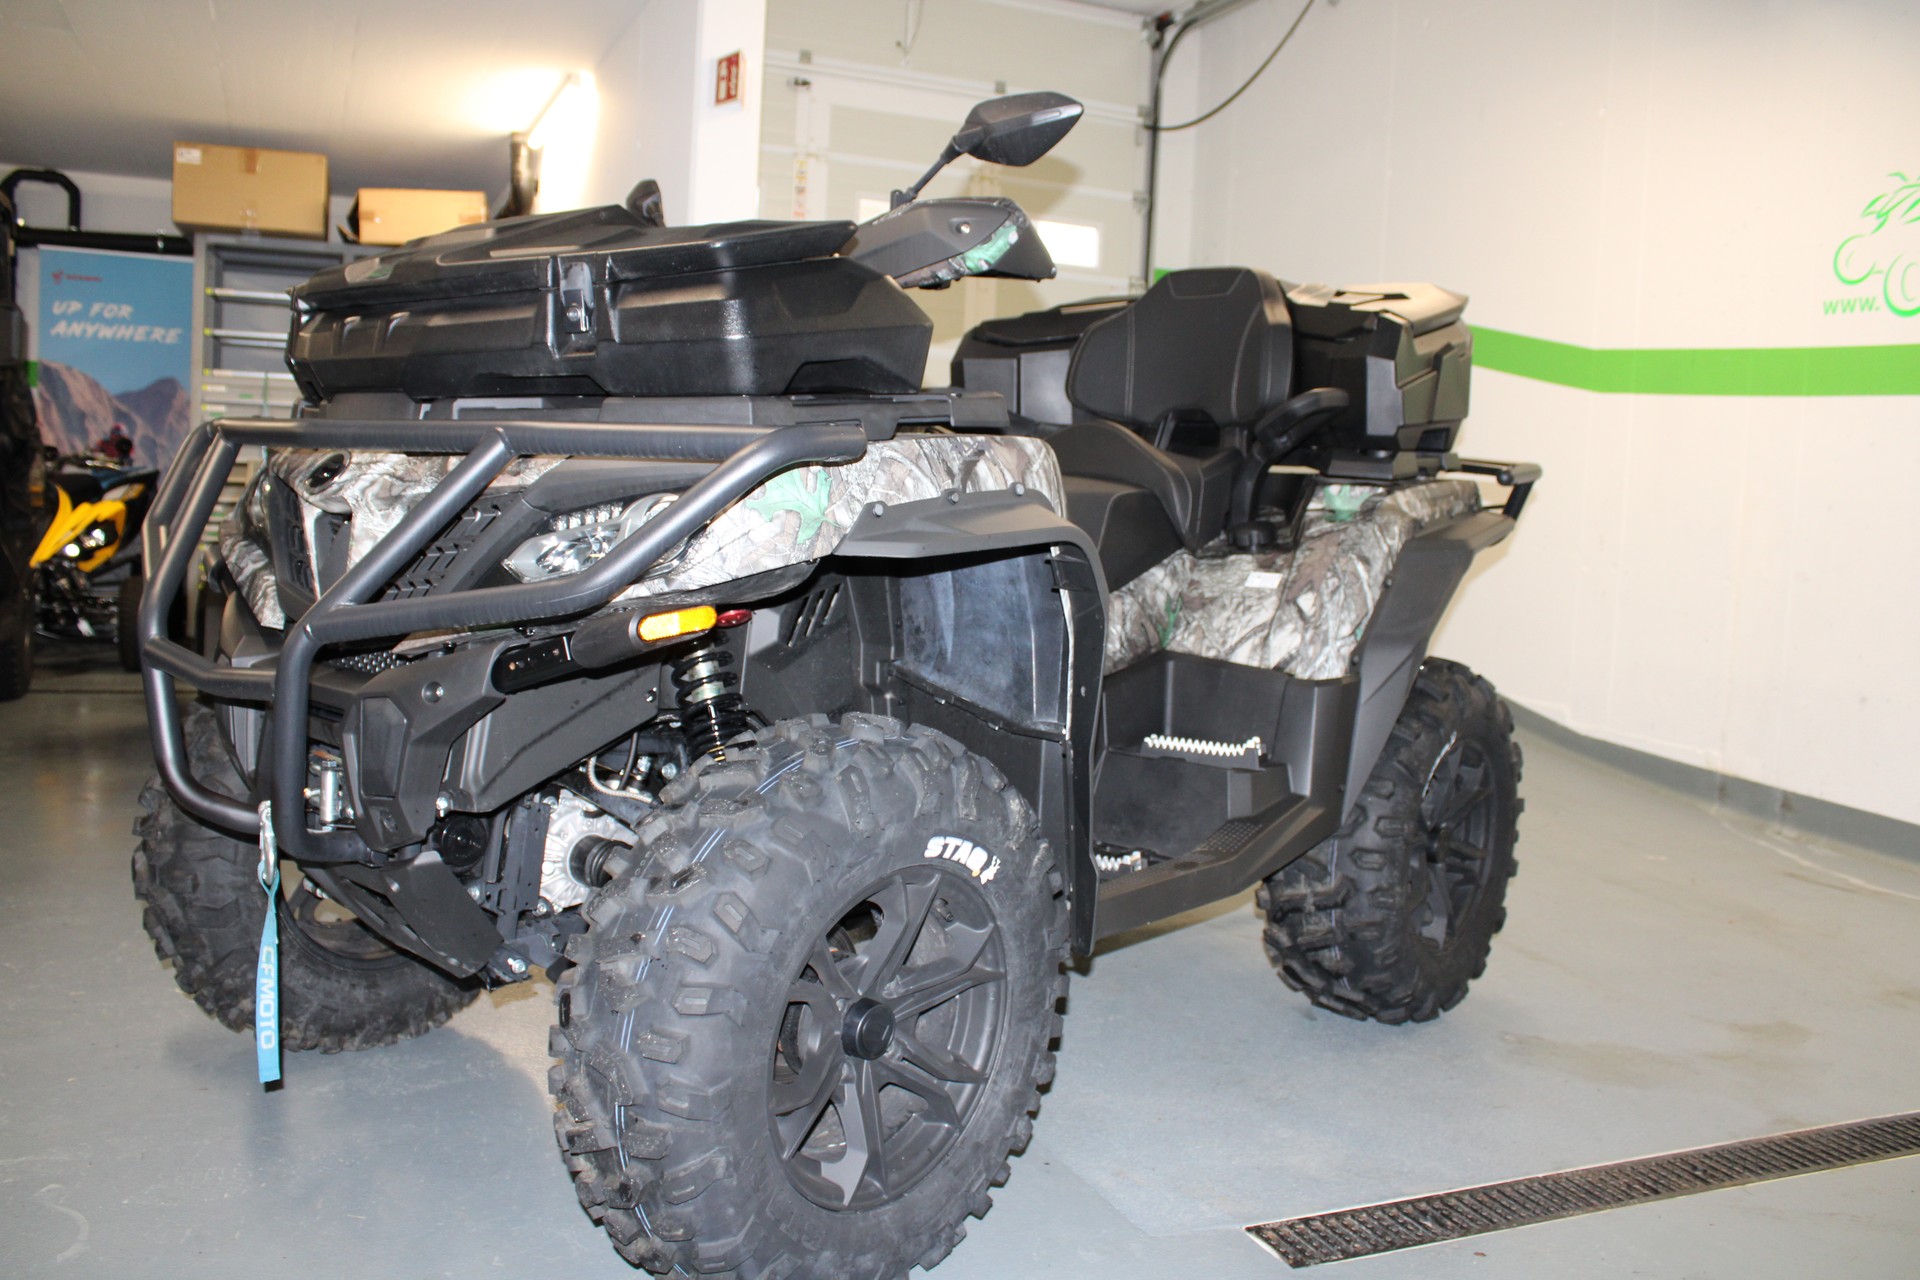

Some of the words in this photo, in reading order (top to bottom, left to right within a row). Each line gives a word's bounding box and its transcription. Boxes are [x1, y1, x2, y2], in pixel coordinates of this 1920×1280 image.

[51, 300, 82, 315] UP
[89, 302, 133, 319] FOR
[51, 320, 181, 344] ANYWHERE
[259, 946, 276, 1049] CFMOTO
